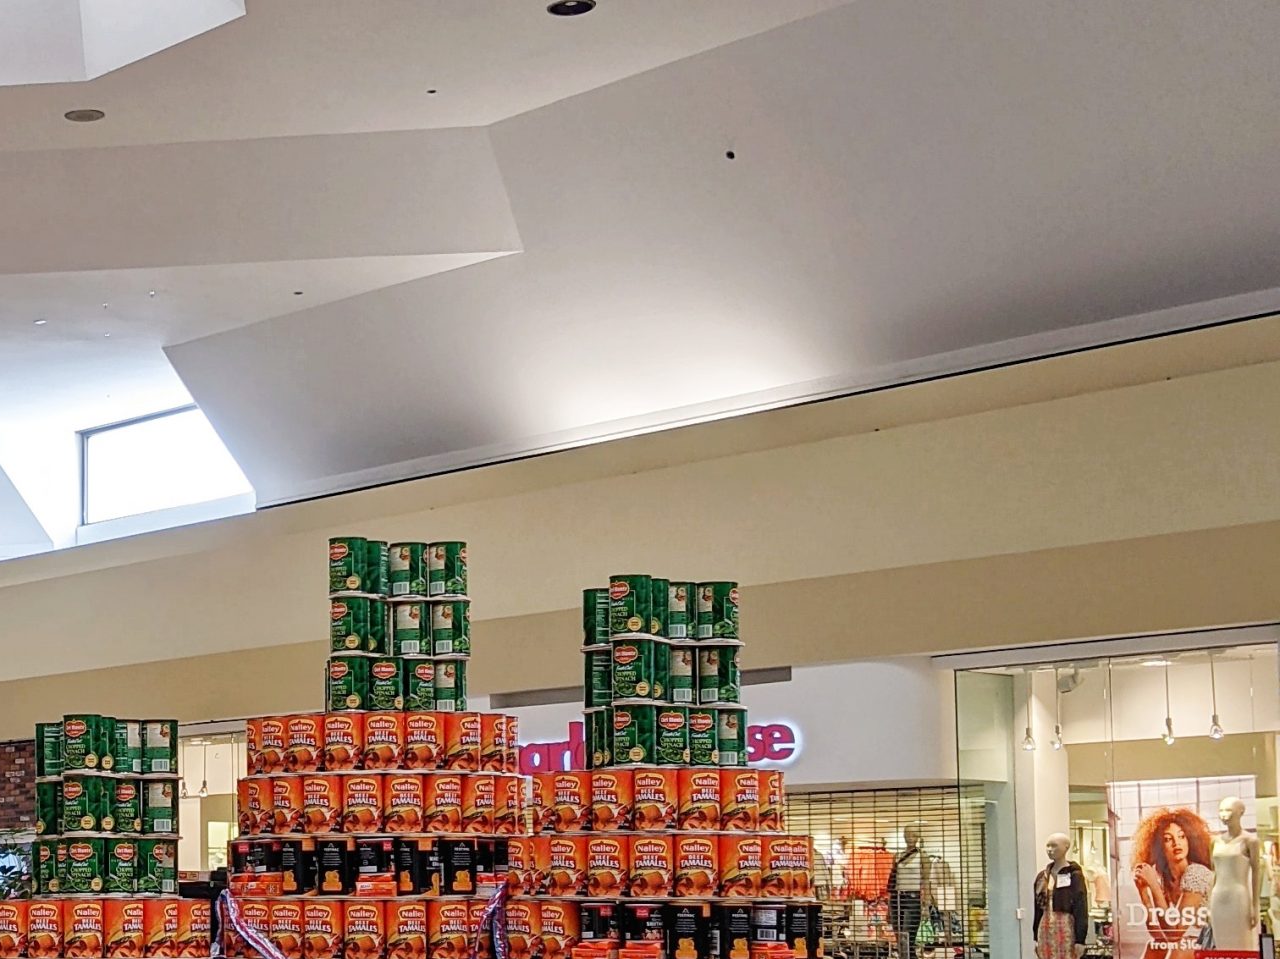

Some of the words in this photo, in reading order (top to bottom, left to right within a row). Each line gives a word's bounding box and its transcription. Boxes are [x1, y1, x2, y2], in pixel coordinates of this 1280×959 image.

[350, 782, 375, 792] Nalley
[348, 797, 377, 806] TAMALES
[637, 842, 666, 854] Nalley
[635, 859, 668, 869] TAMALES
[76, 908, 101, 918] Nalley
[74, 923, 102, 932] TAMALES
[1150, 940, 1179, 950] from
